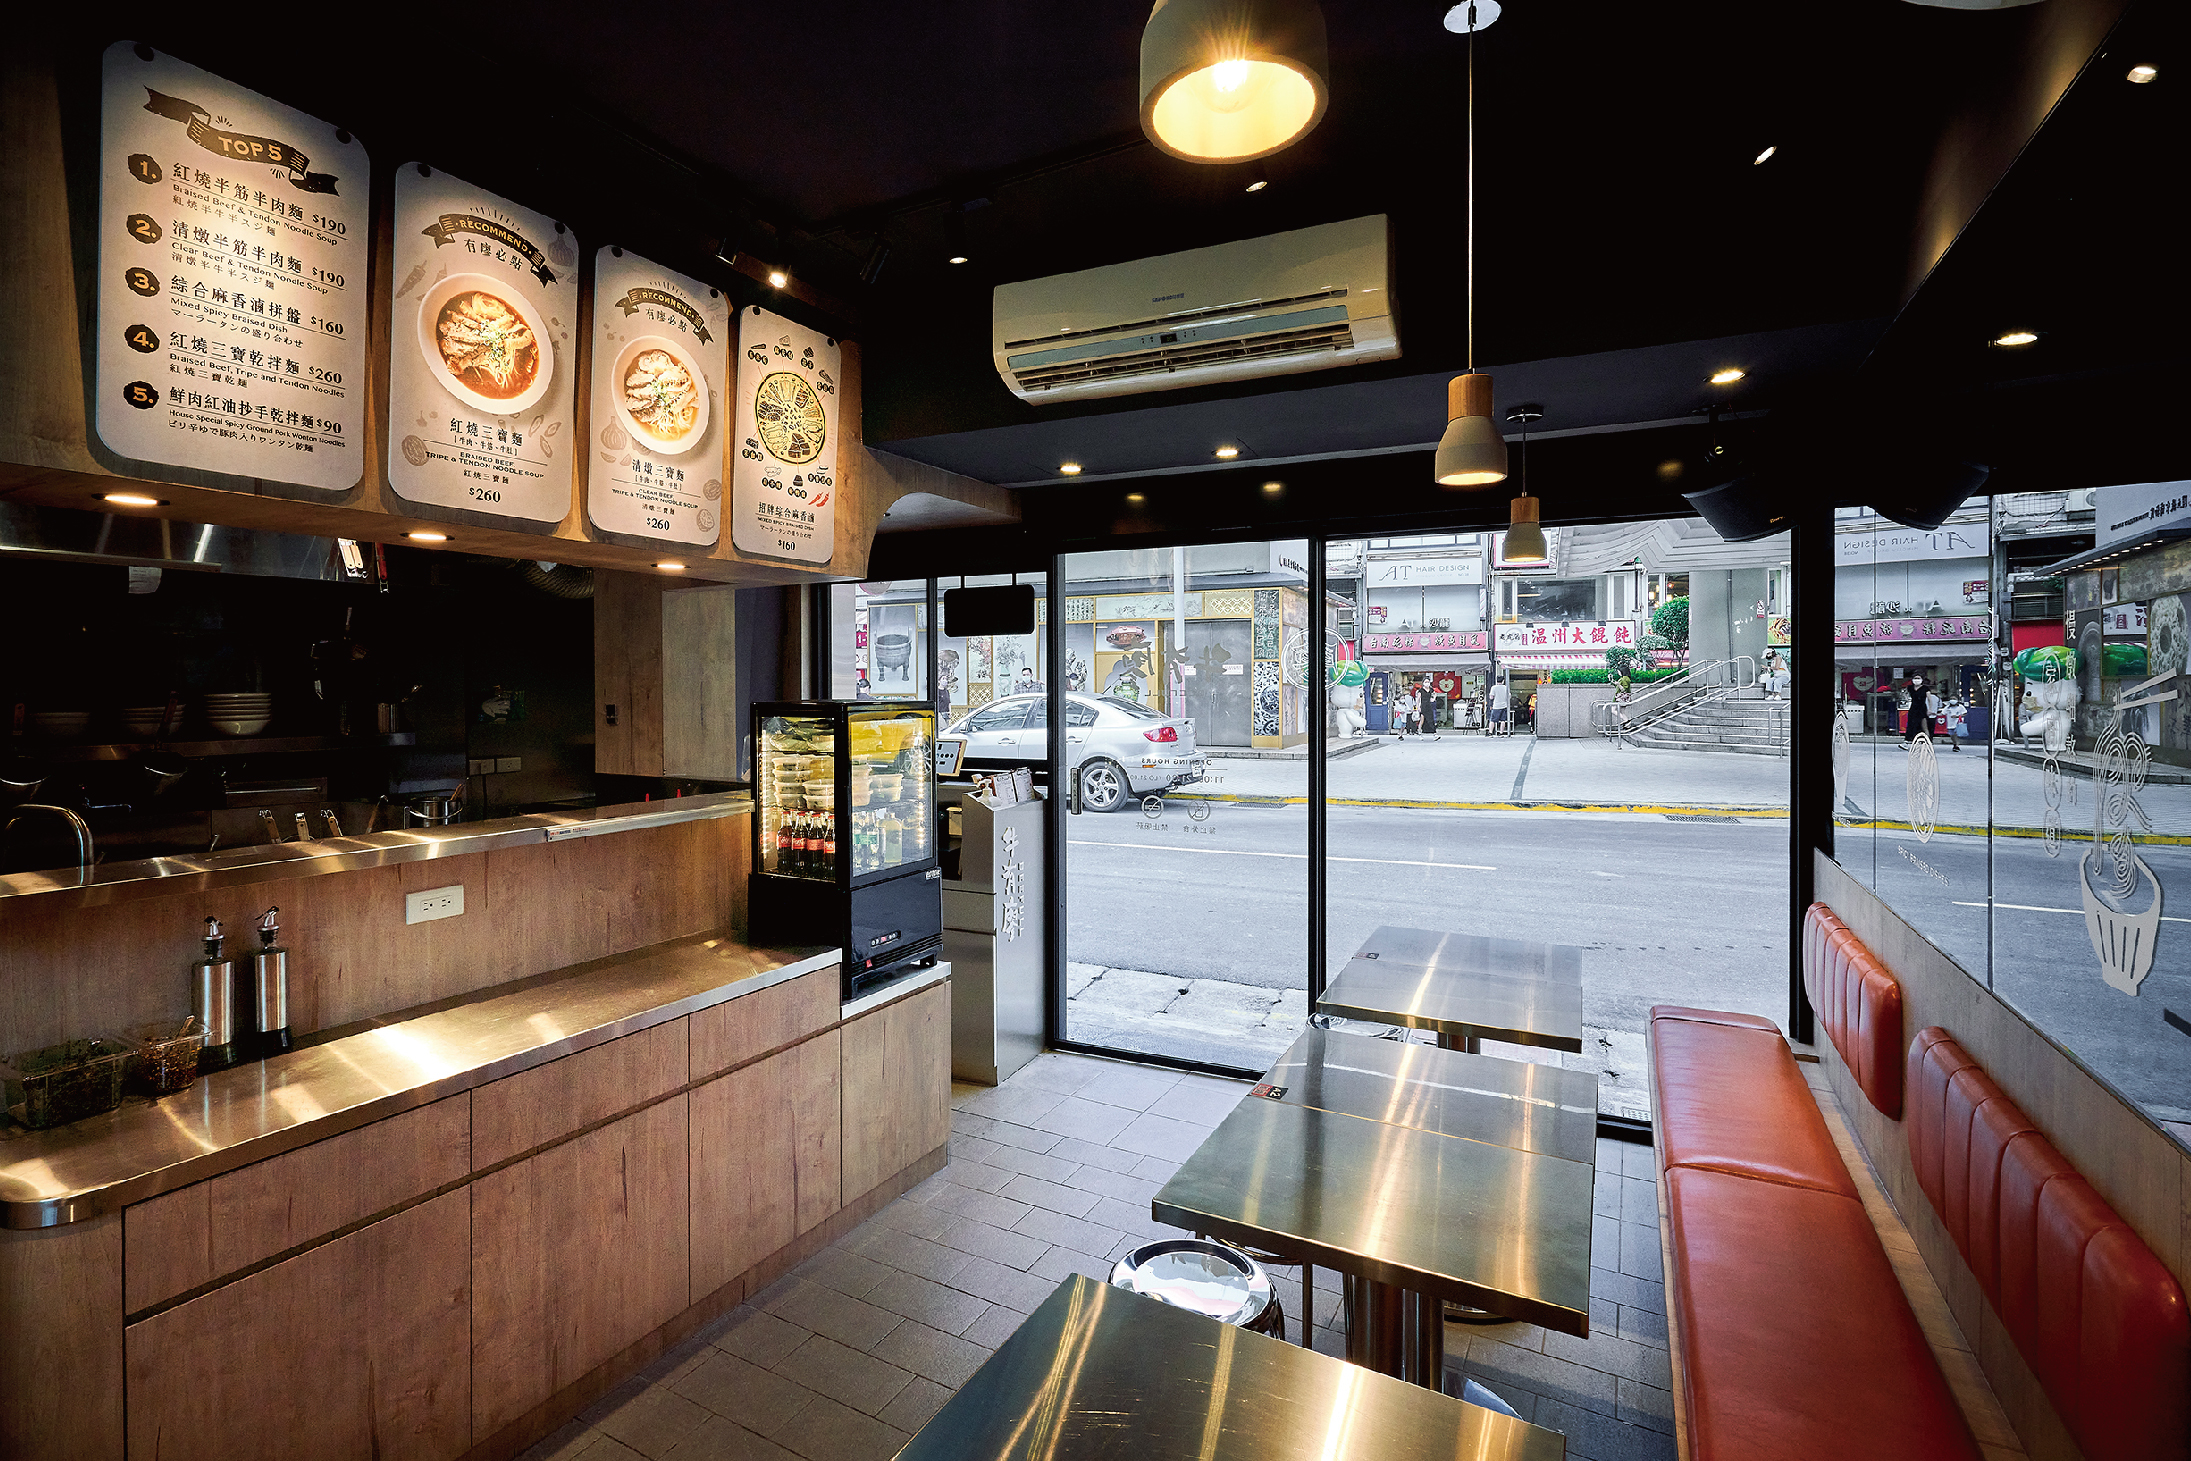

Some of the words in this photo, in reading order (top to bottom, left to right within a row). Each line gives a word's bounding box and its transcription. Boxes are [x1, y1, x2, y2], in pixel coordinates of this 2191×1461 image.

[218, 136, 264, 156] TOP
[267, 143, 283, 161] 5
[173, 162, 303, 221] 紅燒半筋半肉麵
[173, 184, 210, 201] Braised
[212, 197, 235, 210] Beef
[237, 206, 245, 215] &
[248, 210, 281, 226] Tendon
[284, 223, 314, 238] Noodle
[317, 233, 338, 246] Soup
[312, 214, 346, 235] $190
[459, 219, 529, 252] RECOMMEND
[171, 242, 199, 255] Clear
[202, 250, 225, 263] Beef
[237, 262, 271, 277] Tendon
[274, 272, 305, 287] Noodle
[307, 283, 328, 295] Soup
[312, 266, 345, 287] $190
[170, 298, 201, 310] Mixed
[203, 306, 229, 319] Spicy
[231, 313, 266, 328] Braised
[268, 323, 288, 333] Dish
[311, 315, 344, 335] $160
[169, 353, 206, 367] Braised
[236, 367, 258, 379] Tripe
[261, 374, 277, 383] and
[279, 378, 310, 390] Tendon
[312, 386, 345, 399] Noodles
[309, 366, 342, 384] $260
[169, 386, 314, 429] 鮮肉紅油抄手乾拌麵
[169, 409, 194, 419] House
[196, 414, 223, 425] Special
[225, 420, 245, 430] Spicy
[246, 423, 273, 434] Ground
[275, 429, 291, 438] Pork
[292, 432, 318, 442] Wonton
[319, 437, 346, 448] Noodles
[316, 418, 342, 434] $90
[450, 418, 523, 447] 紅燒三寶麵
[425, 451, 449, 461] TRIPE
[459, 458, 491, 469] TENDON
[493, 465, 524, 476] NOODLE
[469, 487, 501, 503] $260
[646, 517, 670, 531] $260
[778, 539, 796, 550] $160
[1379, 565, 1412, 581] AT
[1439, 564, 1470, 572] DESIGN
